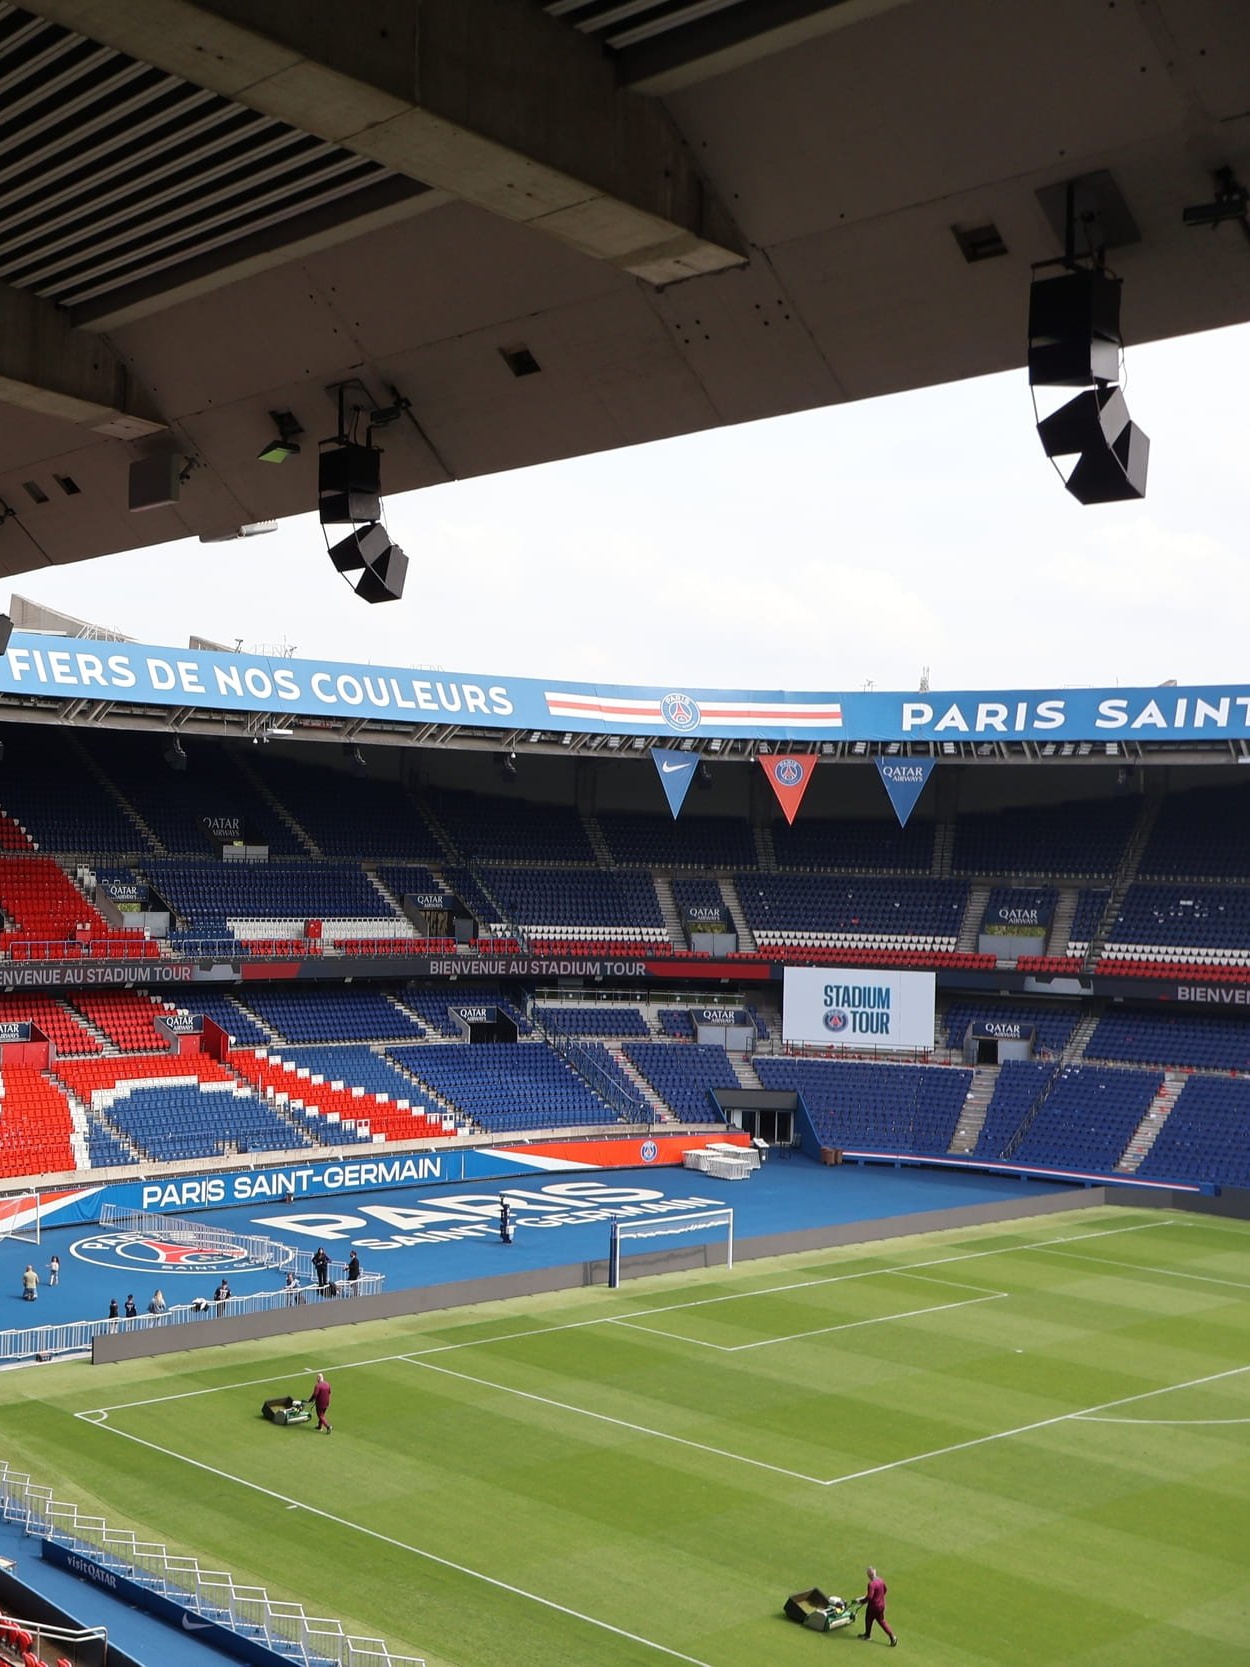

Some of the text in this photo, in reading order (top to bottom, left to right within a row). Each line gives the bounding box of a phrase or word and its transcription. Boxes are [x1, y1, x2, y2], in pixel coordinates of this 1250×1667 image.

[7, 648, 515, 715] FIERS DE NOS COULEURS
[901, 697, 1250, 732] PARIS SAINT
[883, 766, 923, 777] QATAR
[213, 829, 239, 838] AIRWAYS
[110, 886, 137, 895] QATAR
[417, 895, 443, 904] QATAR
[690, 908, 719, 917] QATAR
[999, 909, 1037, 919] QATAR
[64, 969, 83, 983] AU
[86, 967, 150, 983] STADIUM
[154, 967, 191, 981] TOUR
[430, 961, 646, 976] BIENVENUE AU STADIUM TOUR
[823, 984, 890, 1009] STADIUM
[1177, 986, 1250, 1004] BIENVE
[460, 1008, 486, 1018] QATAR
[704, 1010, 734, 1019] QATAR
[166, 1016, 193, 1027] QATAR
[850, 1010, 890, 1035] TOUR
[985, 1023, 1020, 1034] QATAR
[142, 1157, 441, 1209] PARIS SAINT-GERMAIN
[250, 1182, 665, 1240] PARIS
[351, 1197, 726, 1250] SAINTGERMAIN
[67, 1555, 117, 1589] visitQATAR
